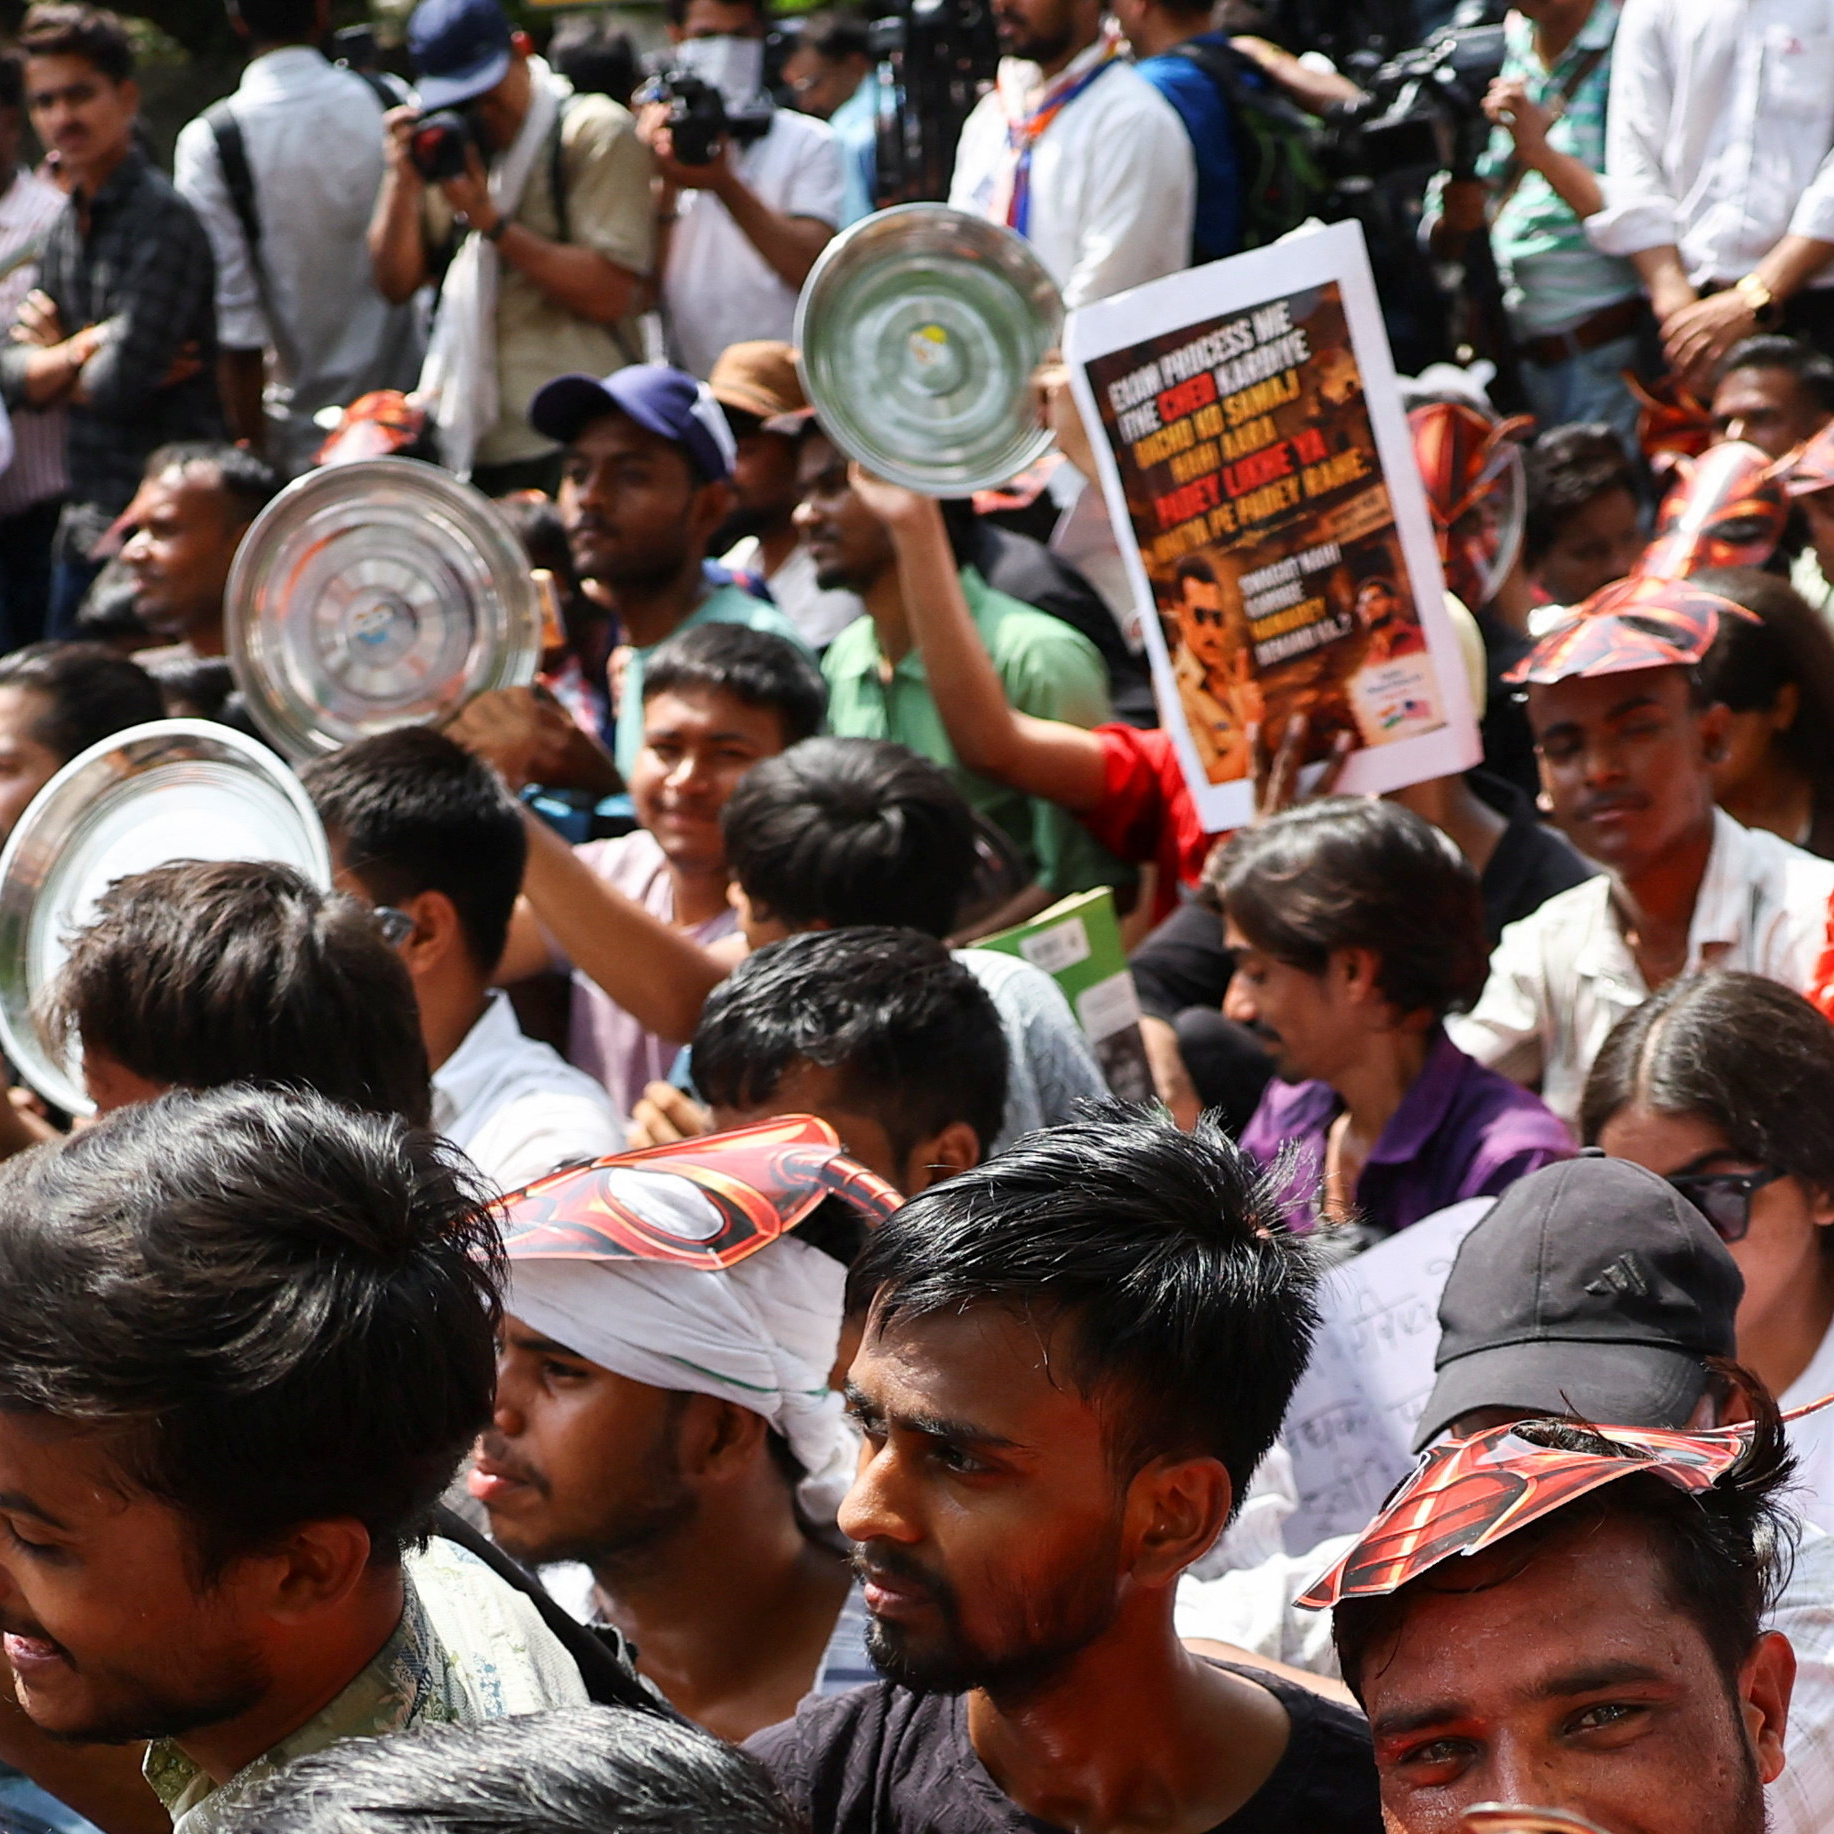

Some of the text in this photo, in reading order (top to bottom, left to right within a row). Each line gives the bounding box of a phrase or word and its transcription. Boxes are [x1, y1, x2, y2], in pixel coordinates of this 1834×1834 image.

[1159, 318, 1256, 386] PROCESS
[1252, 300, 1294, 344] ME
[1213, 328, 1312, 398] KARDIYE
[1192, 402, 1227, 440] KO
[1222, 368, 1302, 427] SAMAJ
[1221, 441, 1294, 497] LIKHE
[1291, 427, 1328, 465] YA
[1207, 502, 1239, 539] PE
